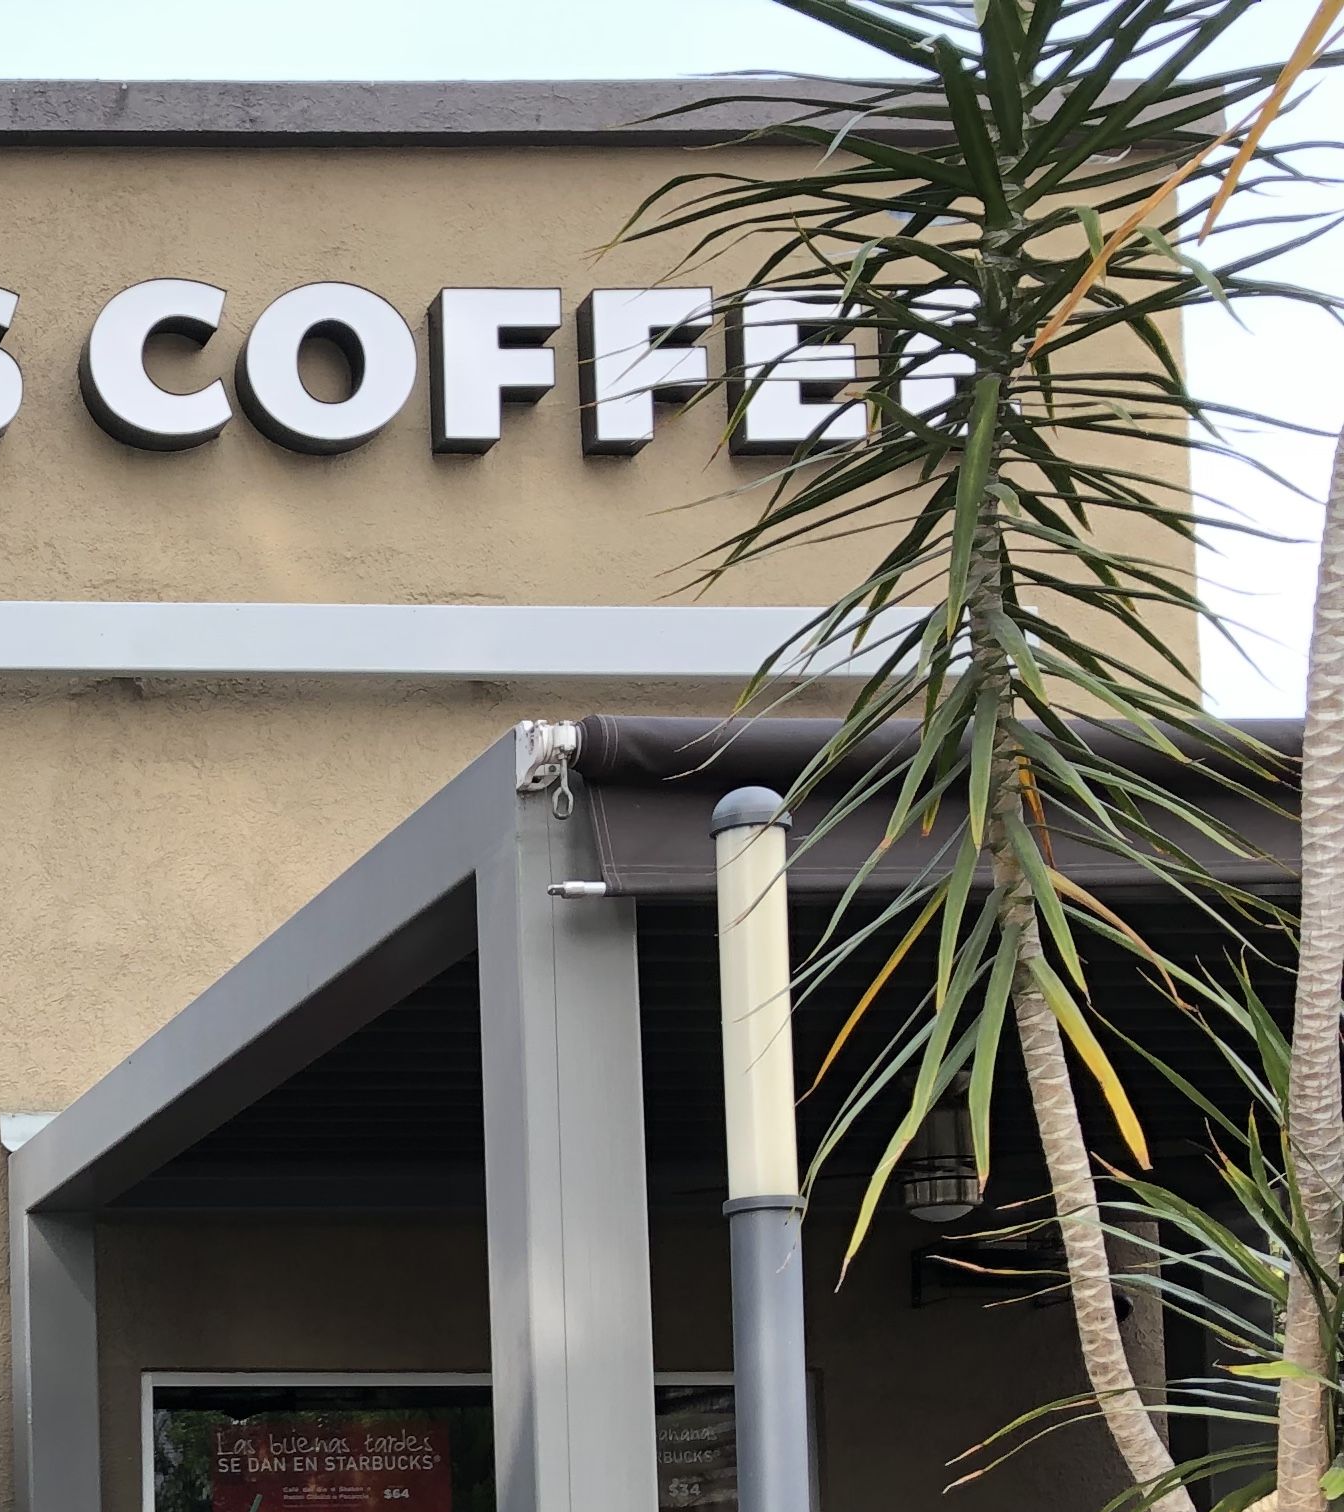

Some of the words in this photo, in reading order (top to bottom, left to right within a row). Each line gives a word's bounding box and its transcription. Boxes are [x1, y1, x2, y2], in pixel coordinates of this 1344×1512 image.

[216, 1432, 256, 1456] Las
[269, 1434, 350, 1456] buenas
[365, 1429, 433, 1453] tardes
[218, 1457, 241, 1472] SE
[248, 1457, 286, 1472] DAN
[293, 1457, 317, 1472] EN
[383, 1488, 410, 1500] $64
[668, 1482, 701, 1497] $34
